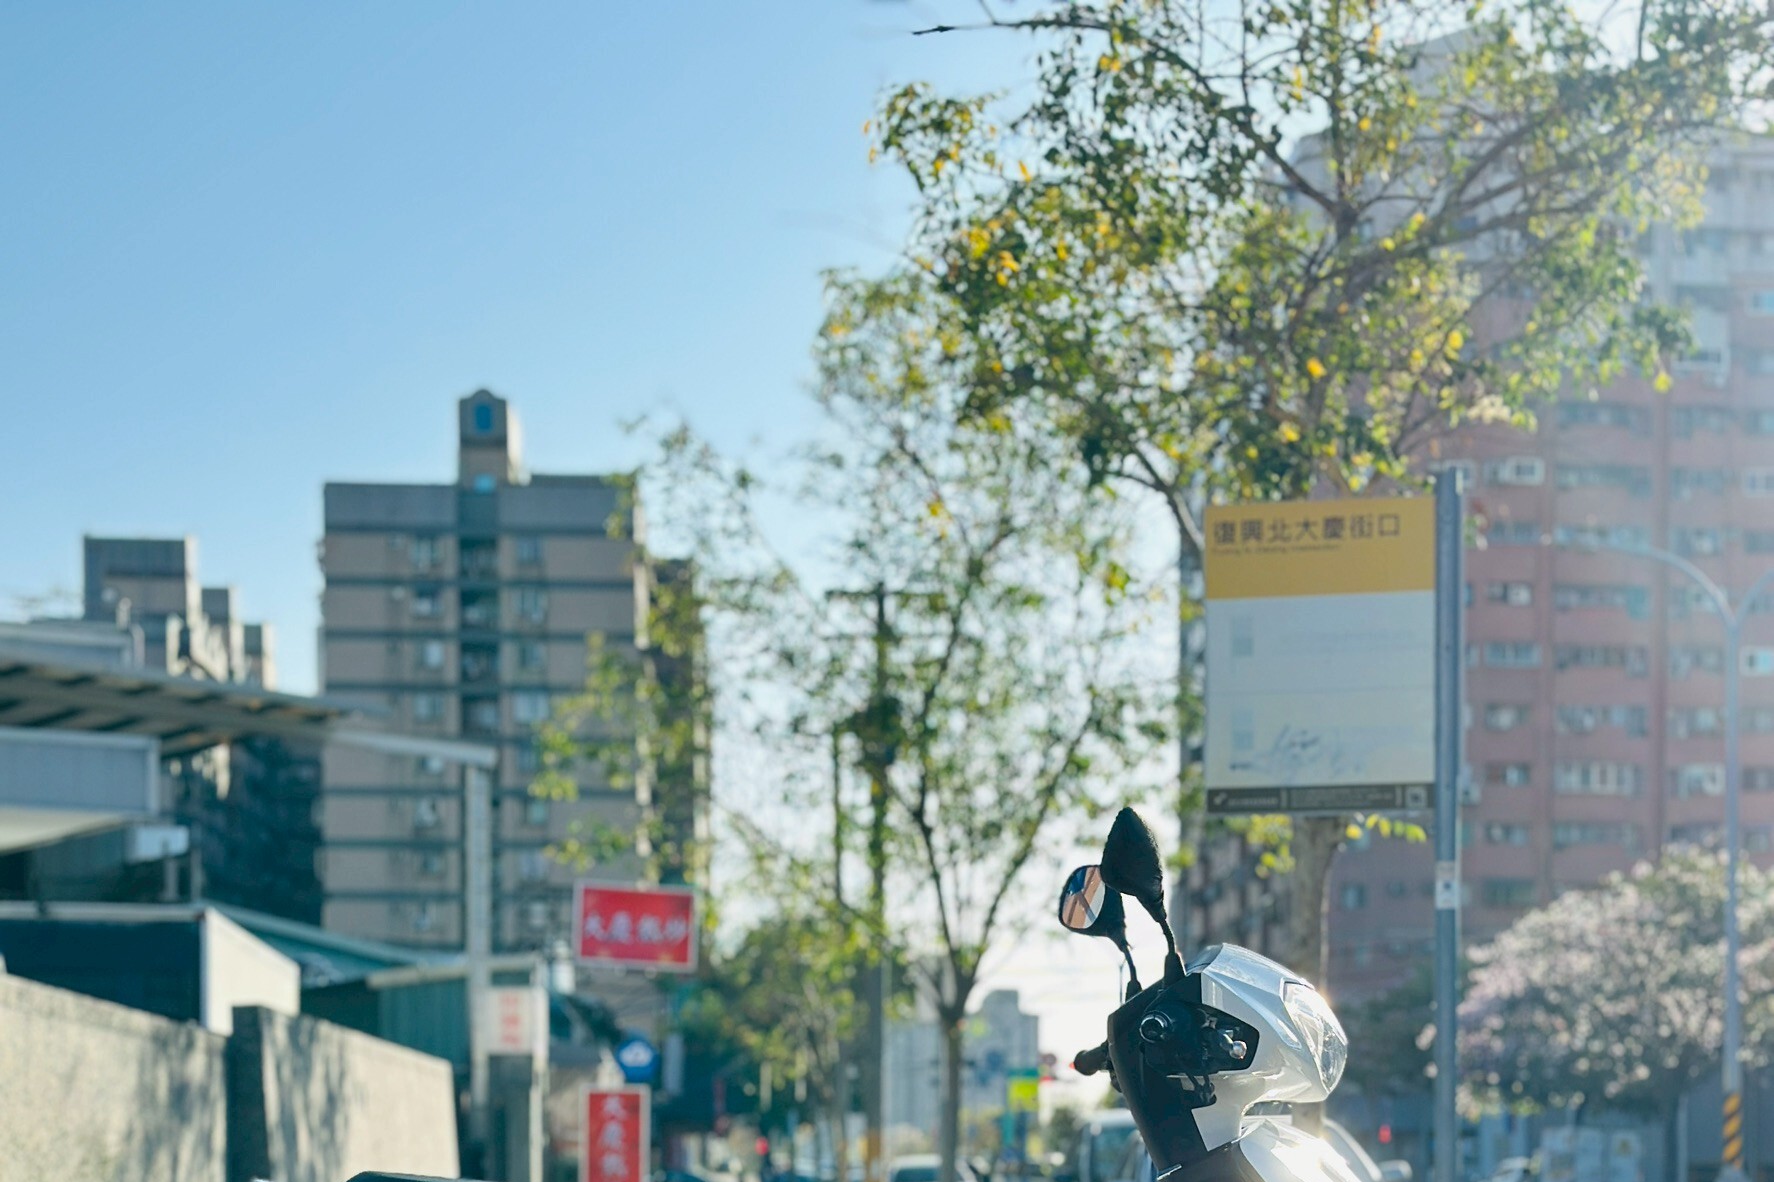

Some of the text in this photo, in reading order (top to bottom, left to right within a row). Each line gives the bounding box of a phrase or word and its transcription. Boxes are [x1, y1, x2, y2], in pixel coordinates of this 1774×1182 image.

[1213, 513, 1400, 544] 復興北大慶街口
